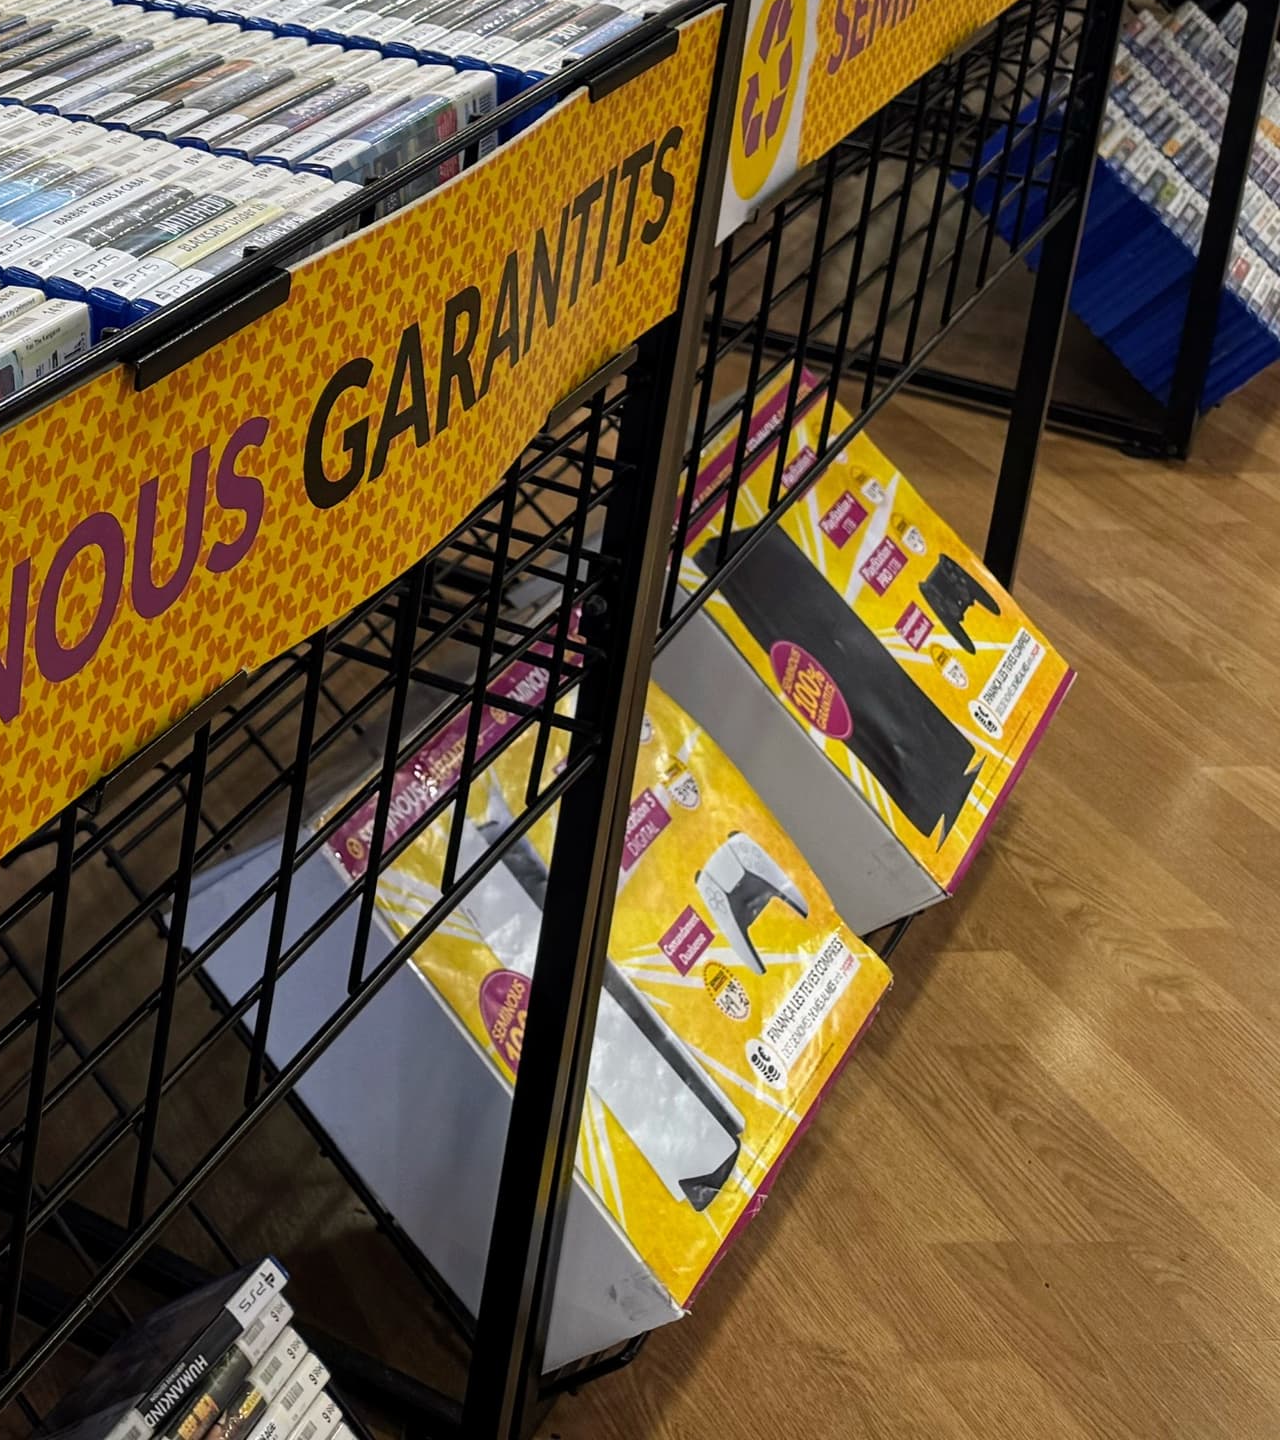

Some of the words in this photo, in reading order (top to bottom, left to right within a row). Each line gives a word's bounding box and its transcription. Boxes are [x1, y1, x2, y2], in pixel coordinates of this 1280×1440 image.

[304, 127, 683, 511] GARANTITS
[492, 978, 526, 1044] SEMINOUS
[143, 1354, 209, 1429] HUMANKIND
